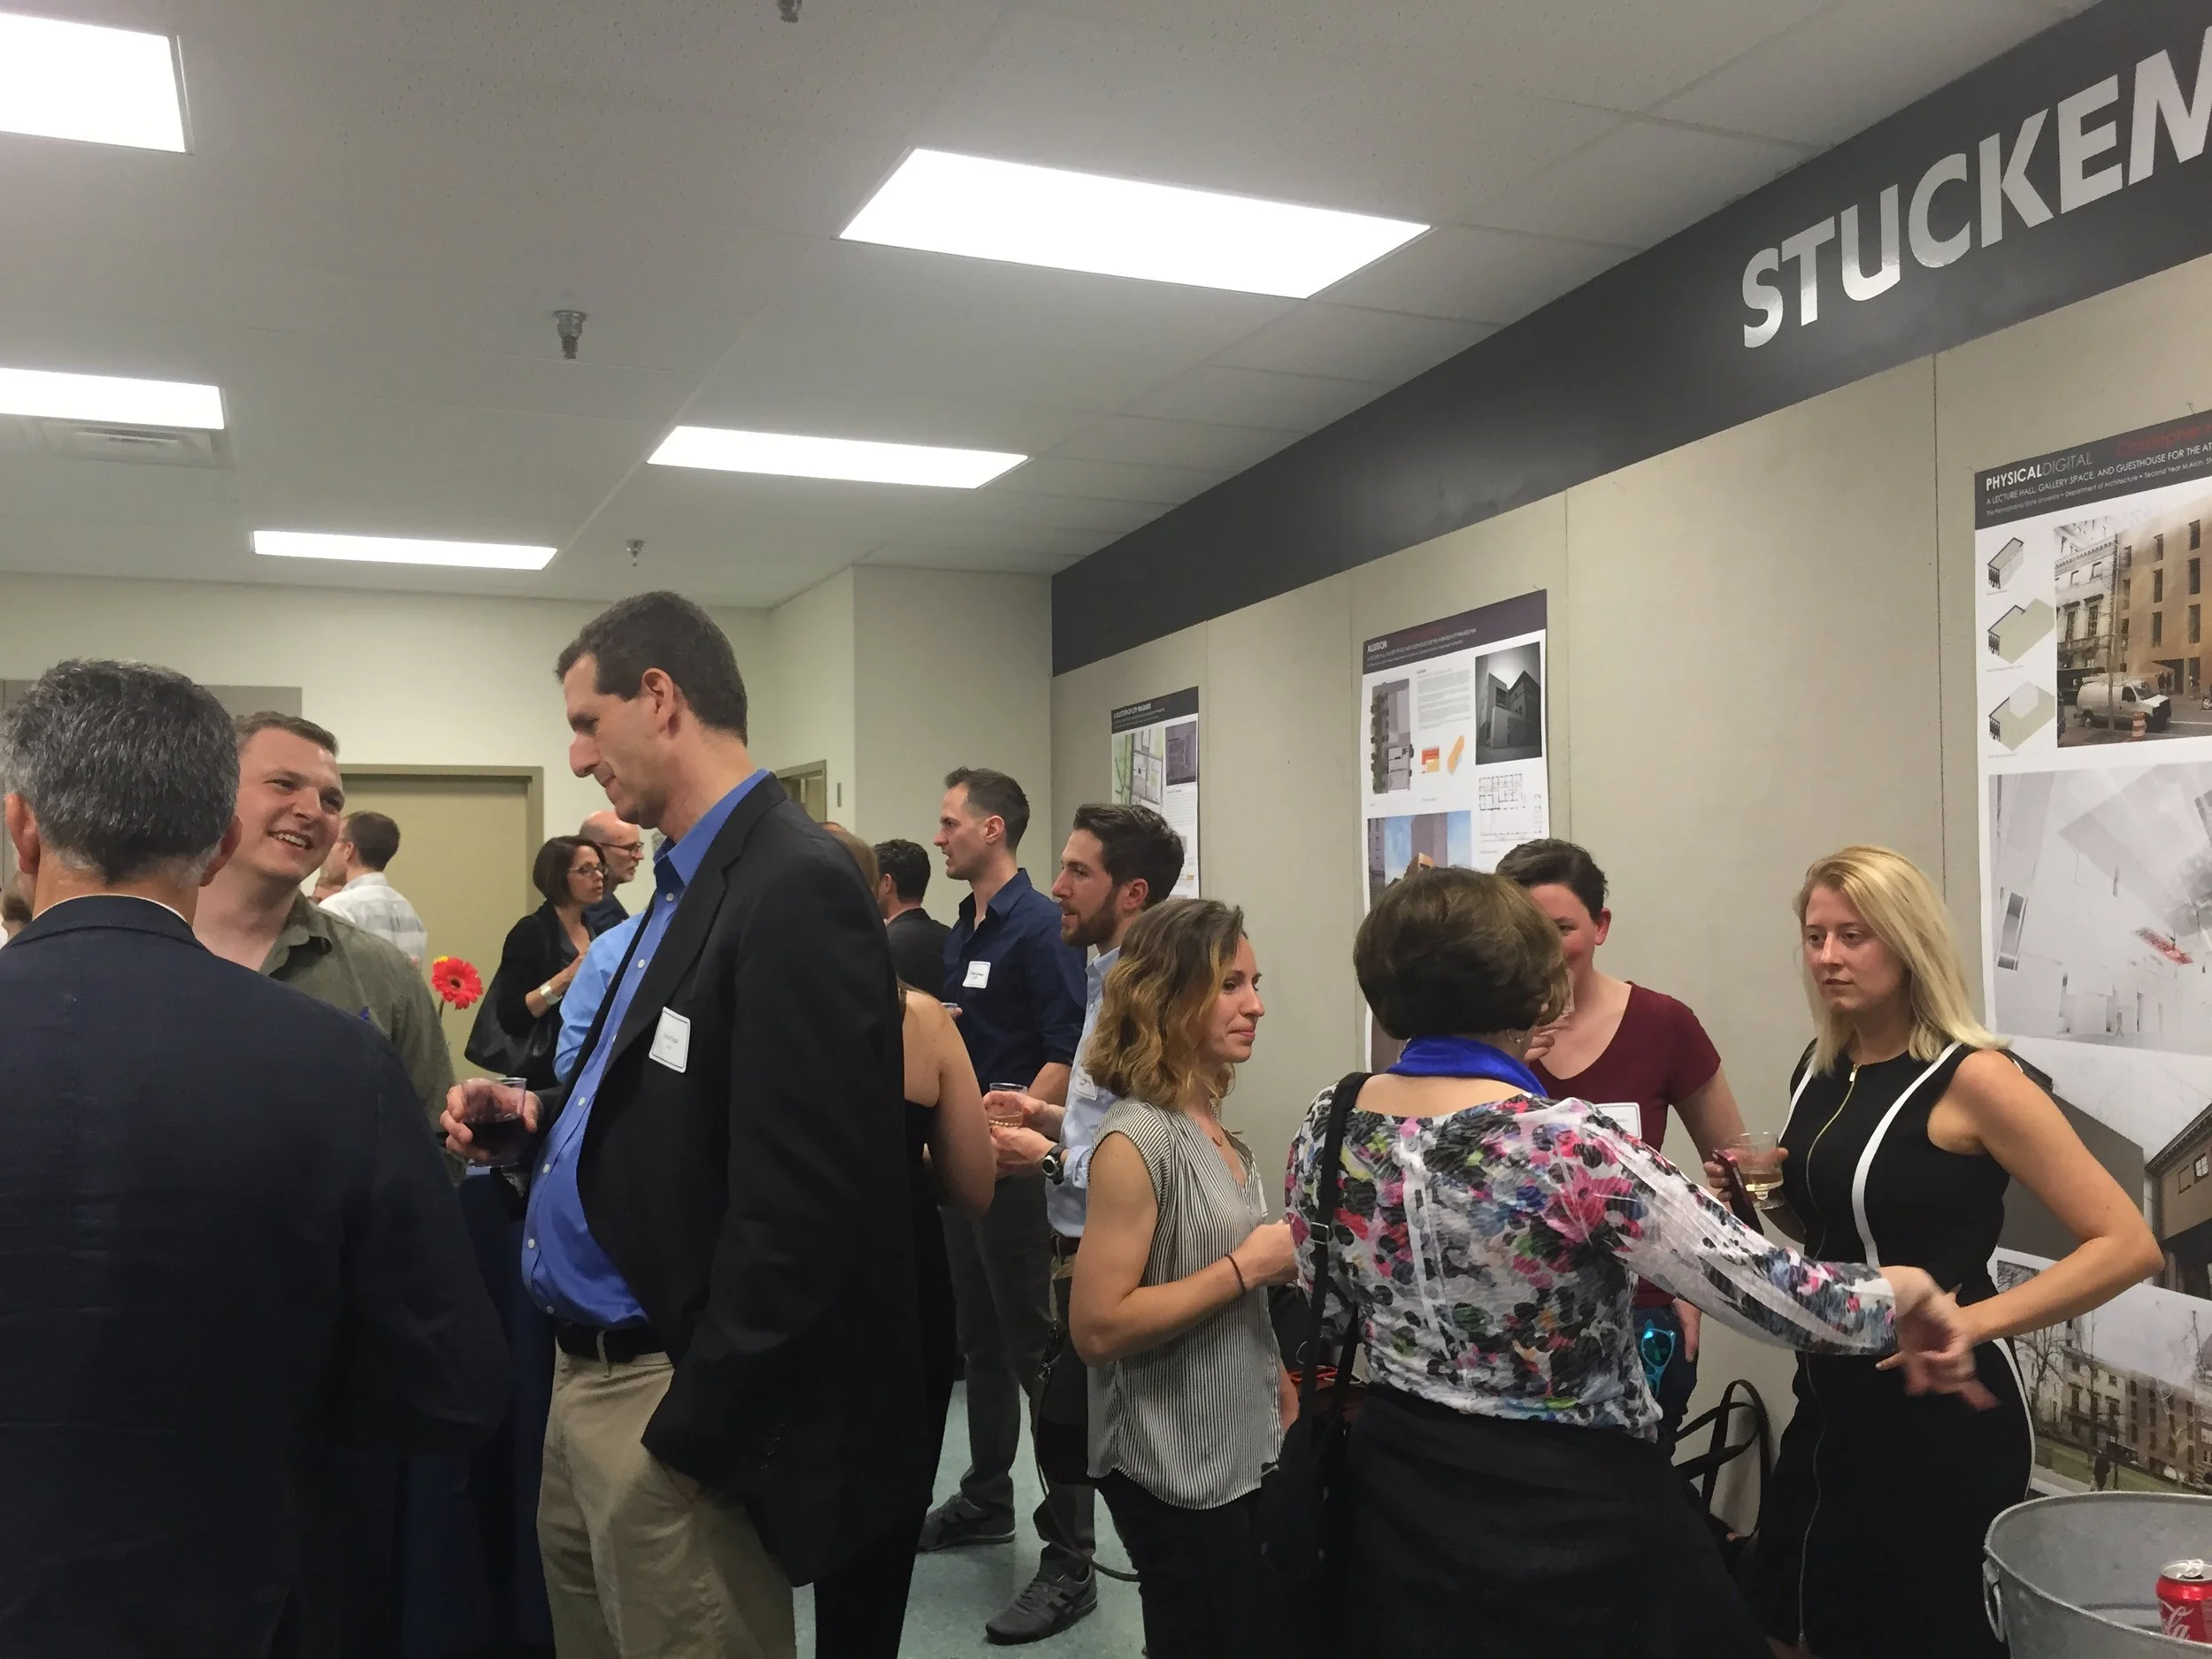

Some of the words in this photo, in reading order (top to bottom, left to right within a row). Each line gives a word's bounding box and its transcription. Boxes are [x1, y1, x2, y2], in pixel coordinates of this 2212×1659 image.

[1992, 489, 2018, 504] LECTURE
[2038, 478, 2069, 492] GALLERY
[2097, 466, 2115, 478] AND
[2116, 453, 2166, 473] GUESTHOUSE
[2167, 449, 2185, 460] FOR
[2186, 445, 2200, 457] THE
[2144, 468, 2166, 479] Second
[2167, 465, 2181, 473] Year
